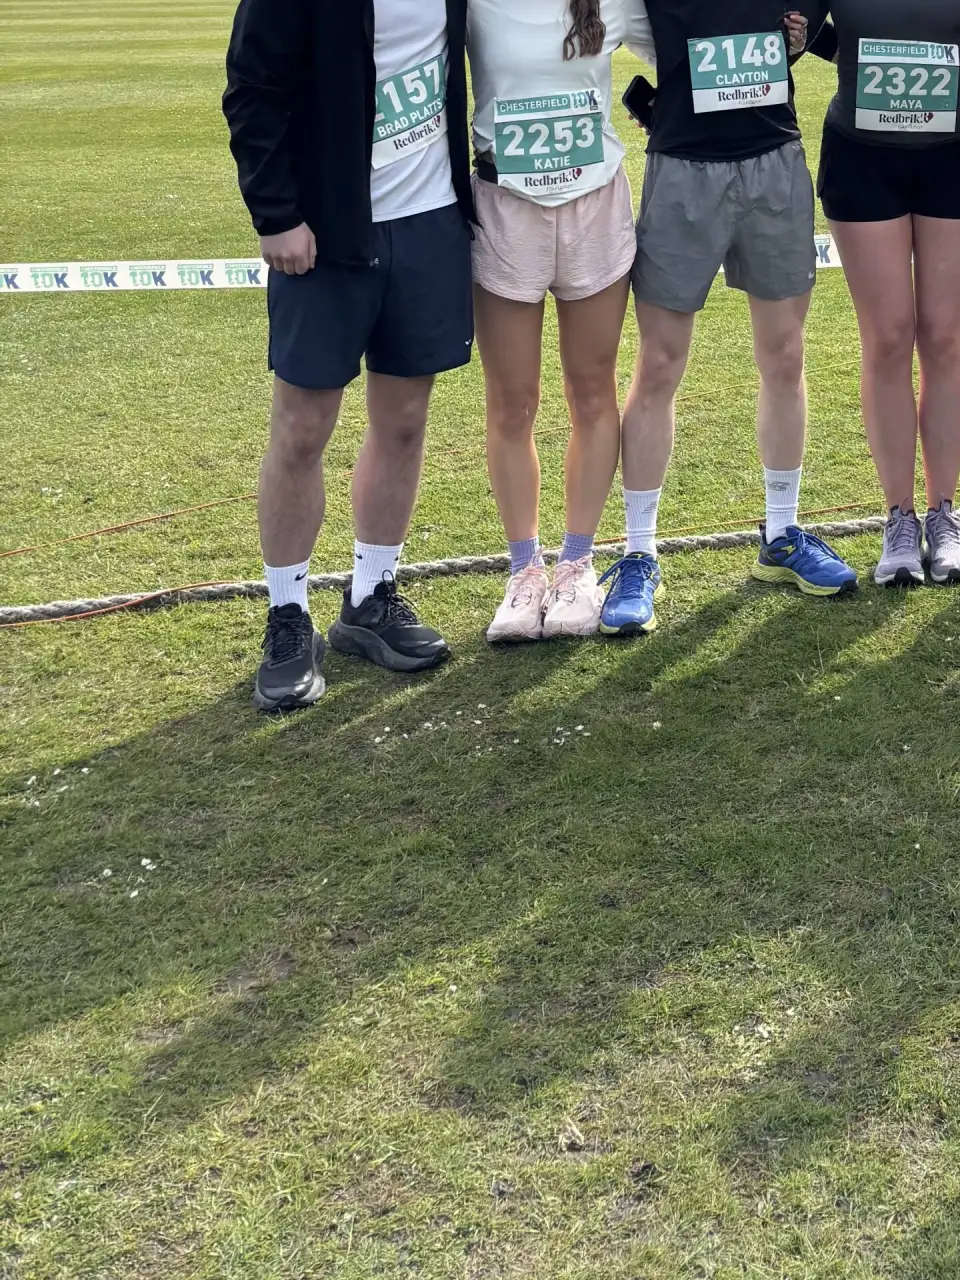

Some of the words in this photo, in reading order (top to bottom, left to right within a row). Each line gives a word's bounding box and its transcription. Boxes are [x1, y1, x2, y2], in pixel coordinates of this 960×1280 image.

[695, 35, 782, 72] 2148
[863, 44, 926, 55] CHESTERFIELD
[928, 44, 955, 61] 10K
[716, 70, 769, 85] CLAYTON
[863, 65, 952, 96] 2322
[500, 97, 568, 113] CHESTERFIELD
[570, 90, 598, 108] 10K
[890, 99, 923, 109] MAYA
[376, 116, 409, 137] BRAD
[409, 98, 443, 124] PLATTS
[502, 117, 595, 156] 2253
[534, 156, 571, 170] KATIE
[31, 273, 70, 288] 10K
[80, 272, 119, 287] 10K
[129, 271, 167, 286] 10K
[178, 270, 214, 286] 10K
[225, 269, 262, 285] 10K
